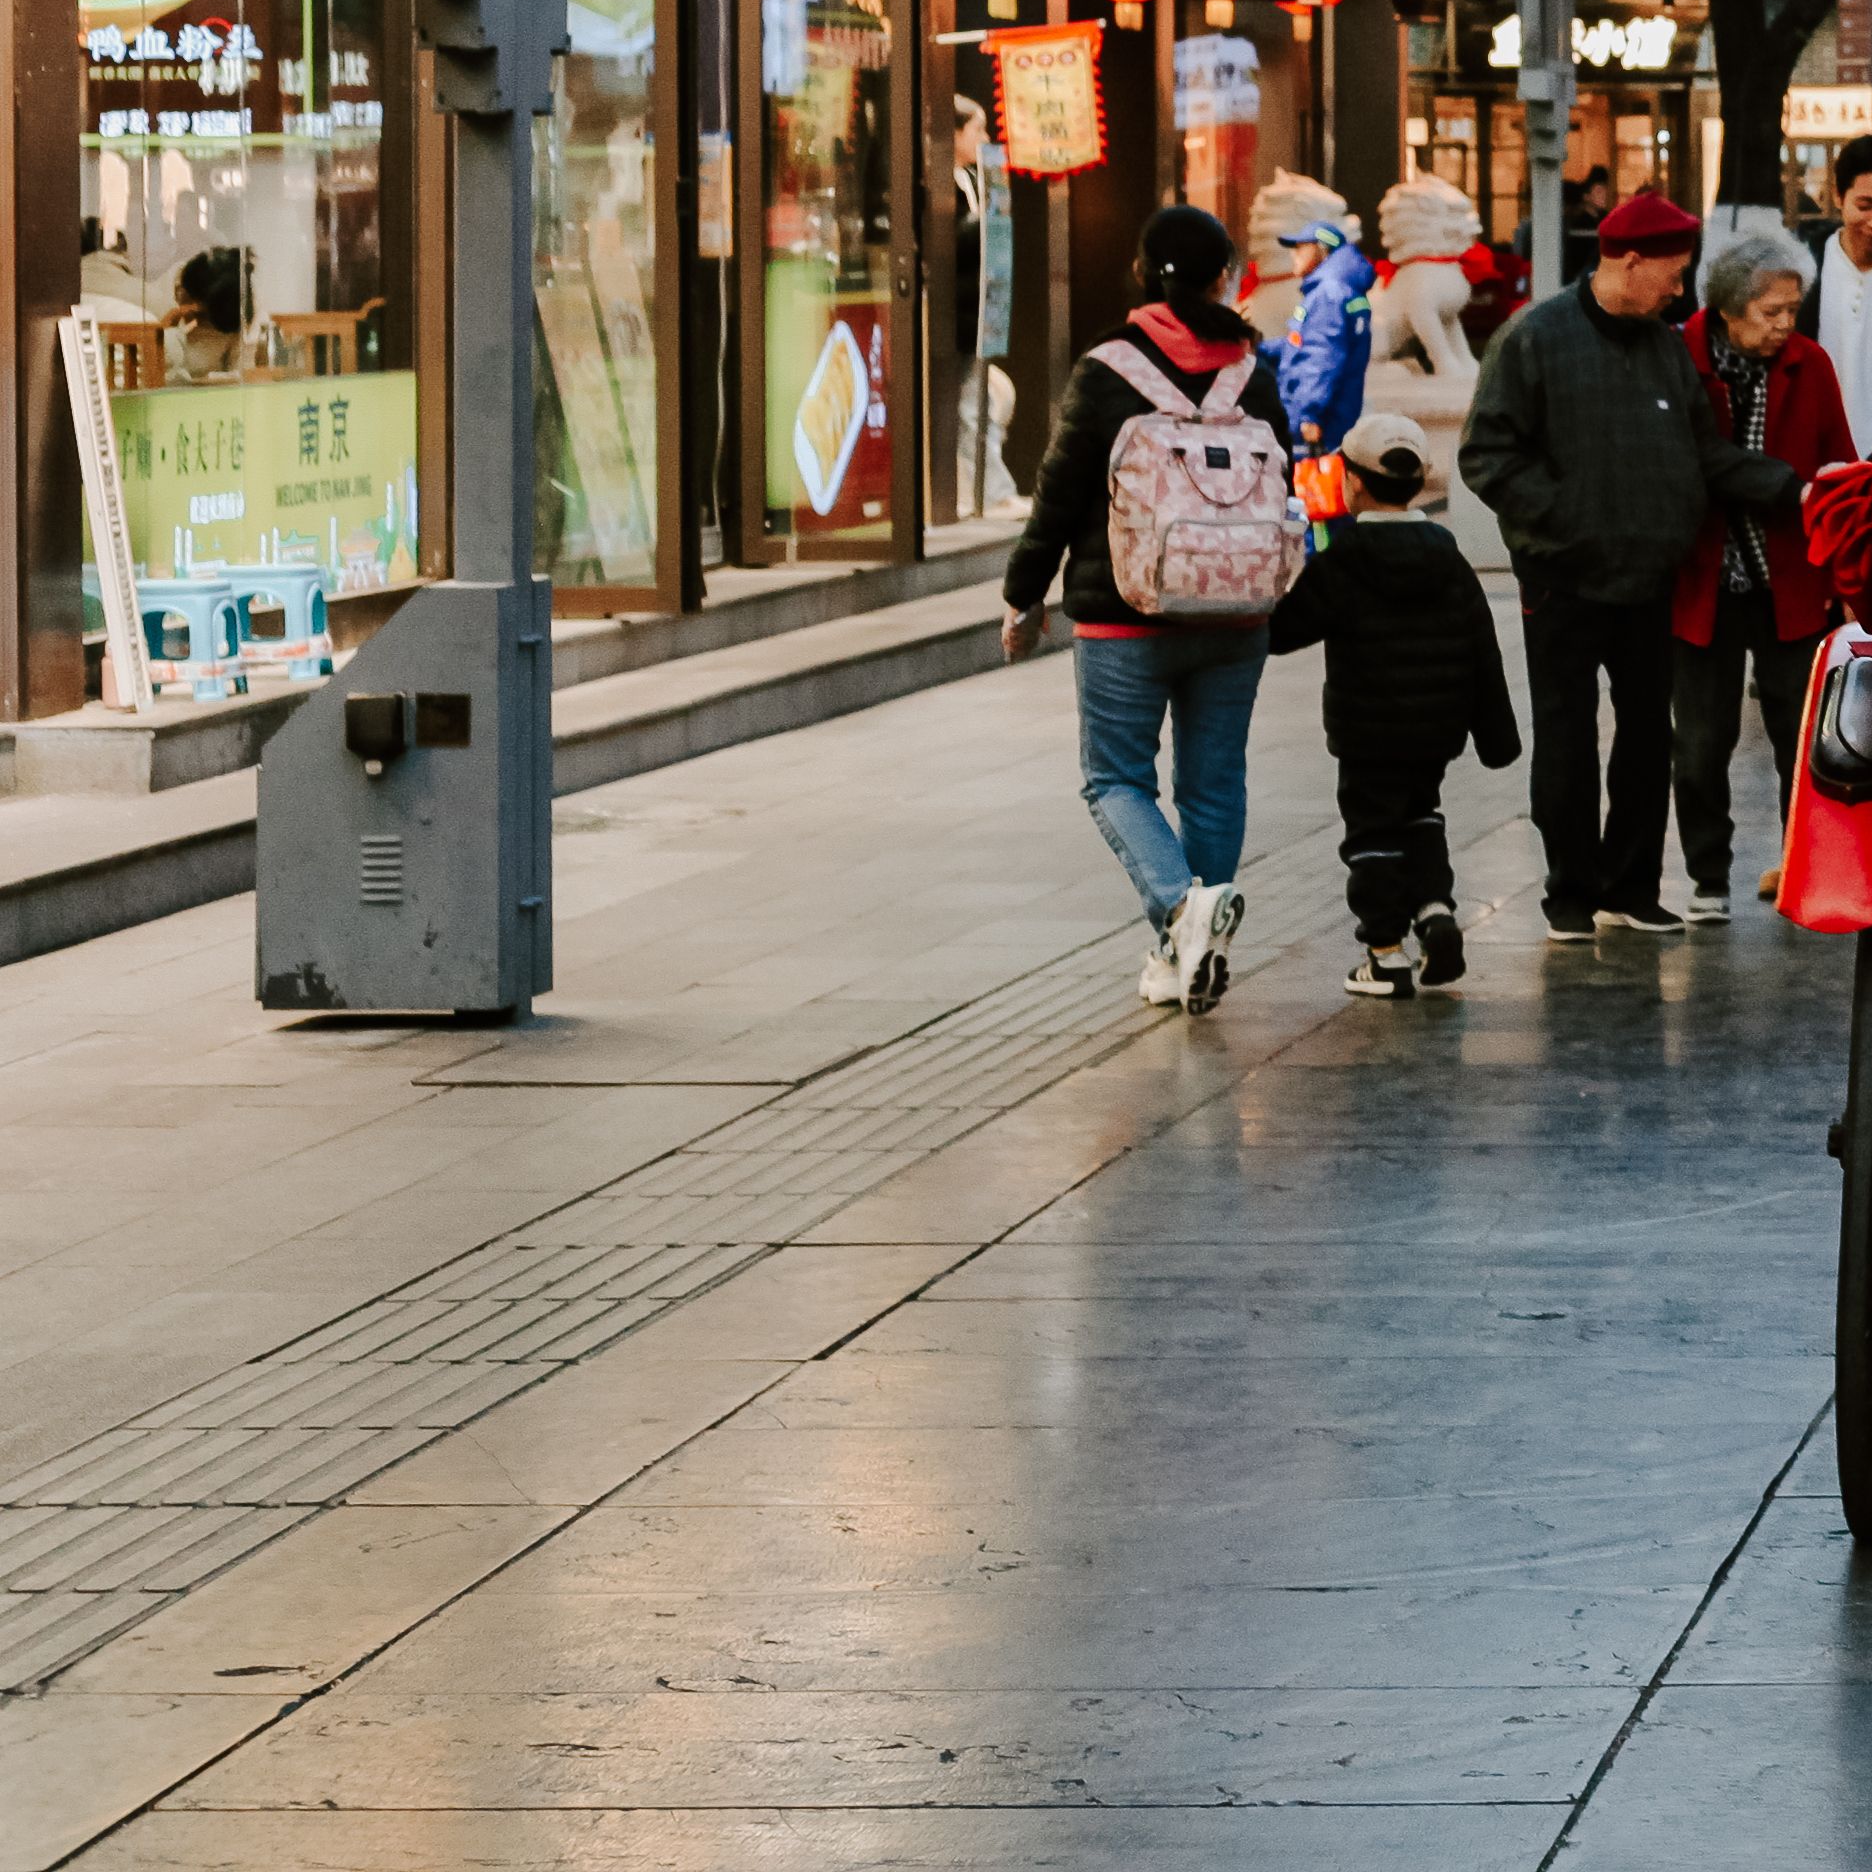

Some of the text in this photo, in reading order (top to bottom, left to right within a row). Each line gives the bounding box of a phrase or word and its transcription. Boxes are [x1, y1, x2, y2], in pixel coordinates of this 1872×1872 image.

[297, 394, 350, 466] 南京
[275, 483, 317, 508] WELCOME
[320, 480, 333, 503] TO
